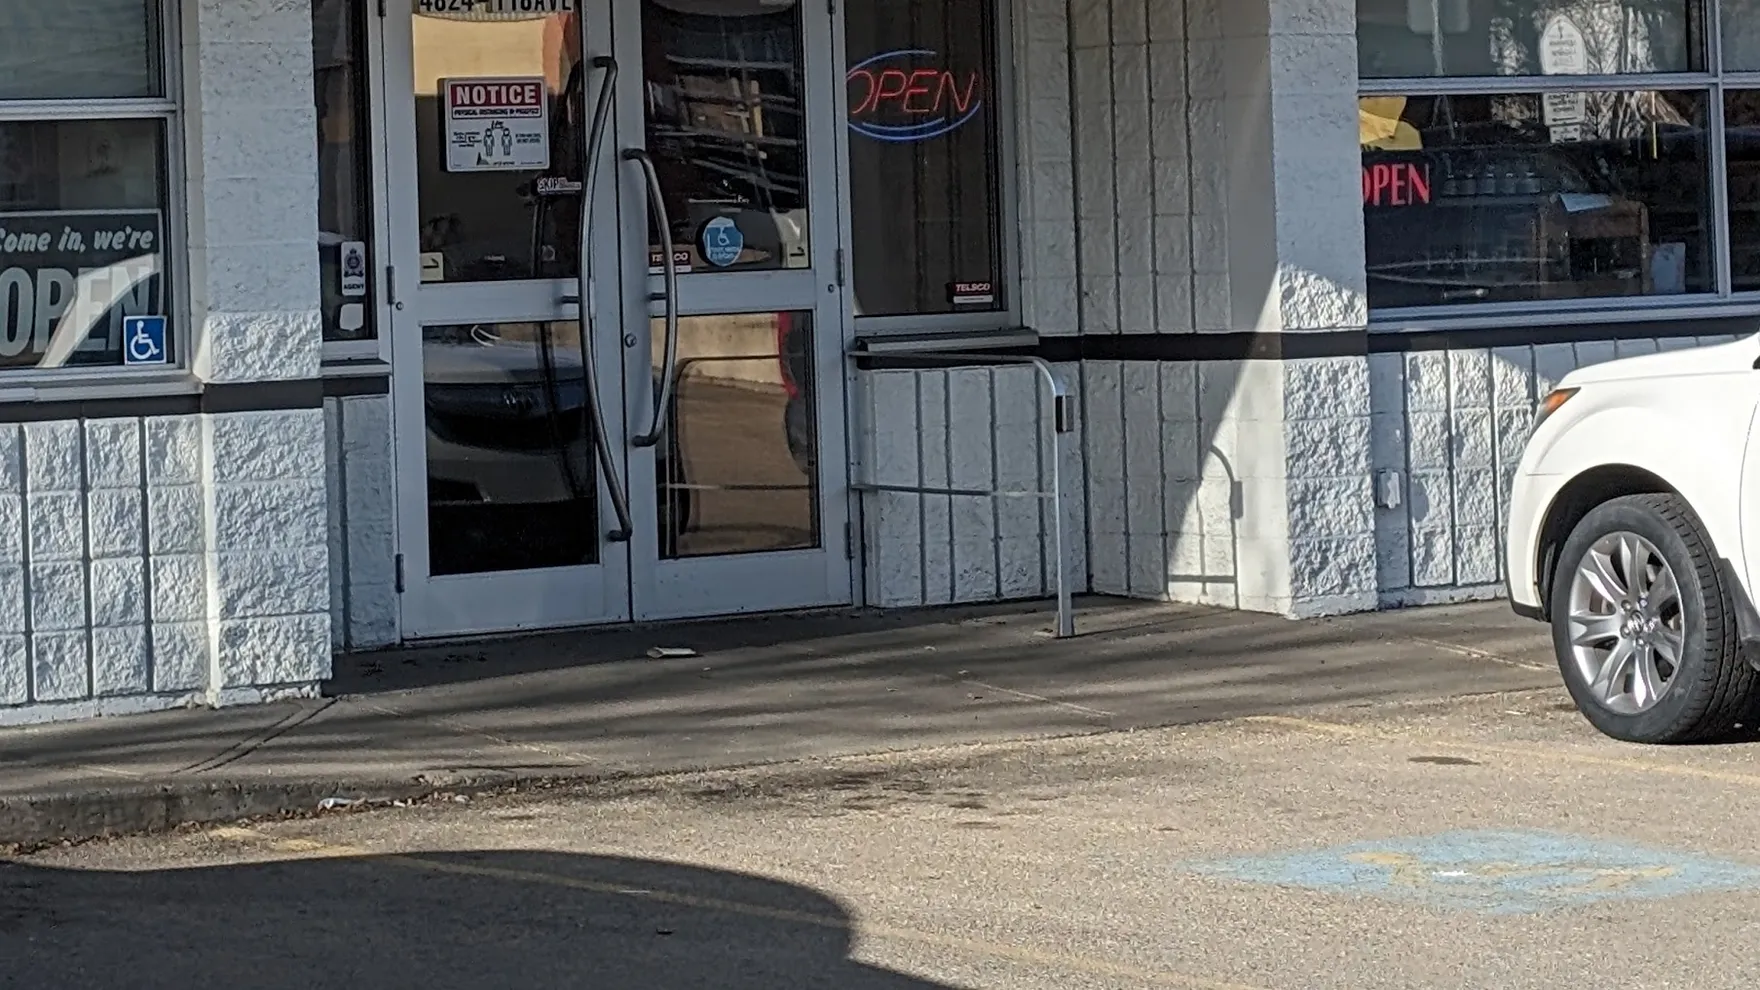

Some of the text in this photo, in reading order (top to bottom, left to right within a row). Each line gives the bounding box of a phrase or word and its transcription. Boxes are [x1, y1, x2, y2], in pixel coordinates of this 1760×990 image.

[455, 84, 537, 105] NOTICE
[846, 69, 976, 114] OPEN
[58, 226, 86, 253] in,
[93, 226, 154, 250] we're
[955, 282, 991, 292] TELSCO
[0, 266, 154, 357] OPEN
